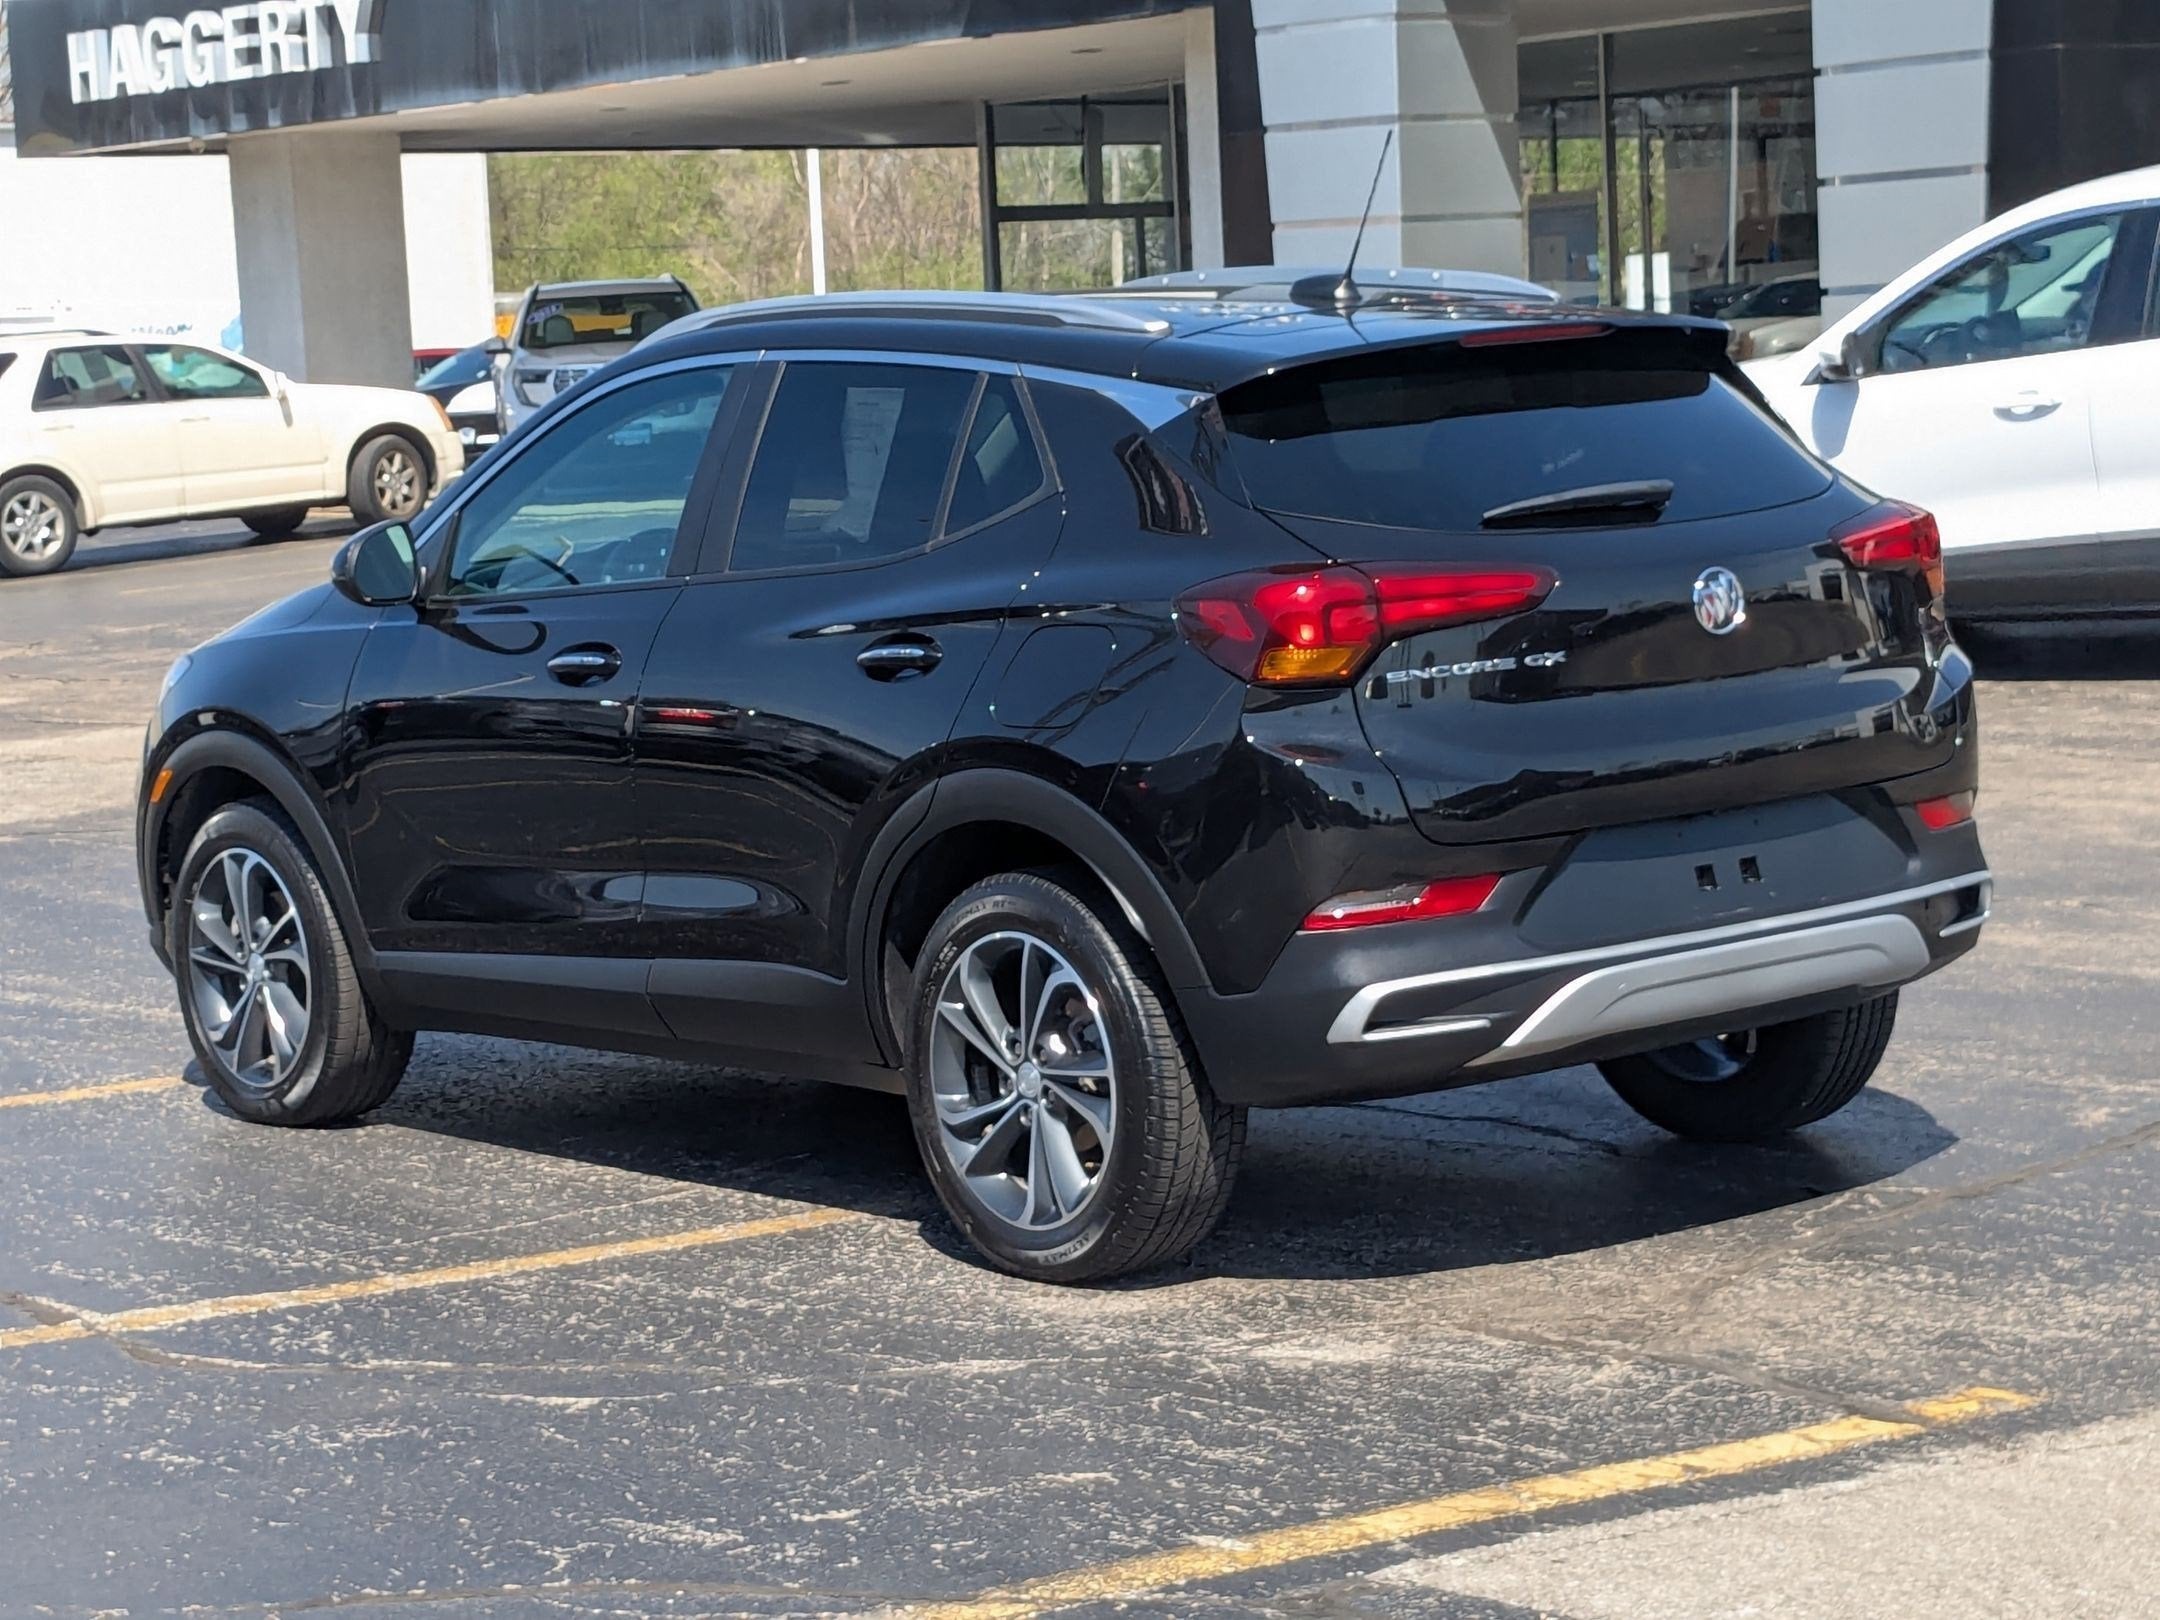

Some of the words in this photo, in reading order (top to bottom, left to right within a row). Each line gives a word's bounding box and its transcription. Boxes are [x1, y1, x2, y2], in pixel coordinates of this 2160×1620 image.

[66, 0, 371, 104] HAGGERTY
[1385, 656, 1517, 684] ENCORE
[1523, 649, 1568, 668] GX
